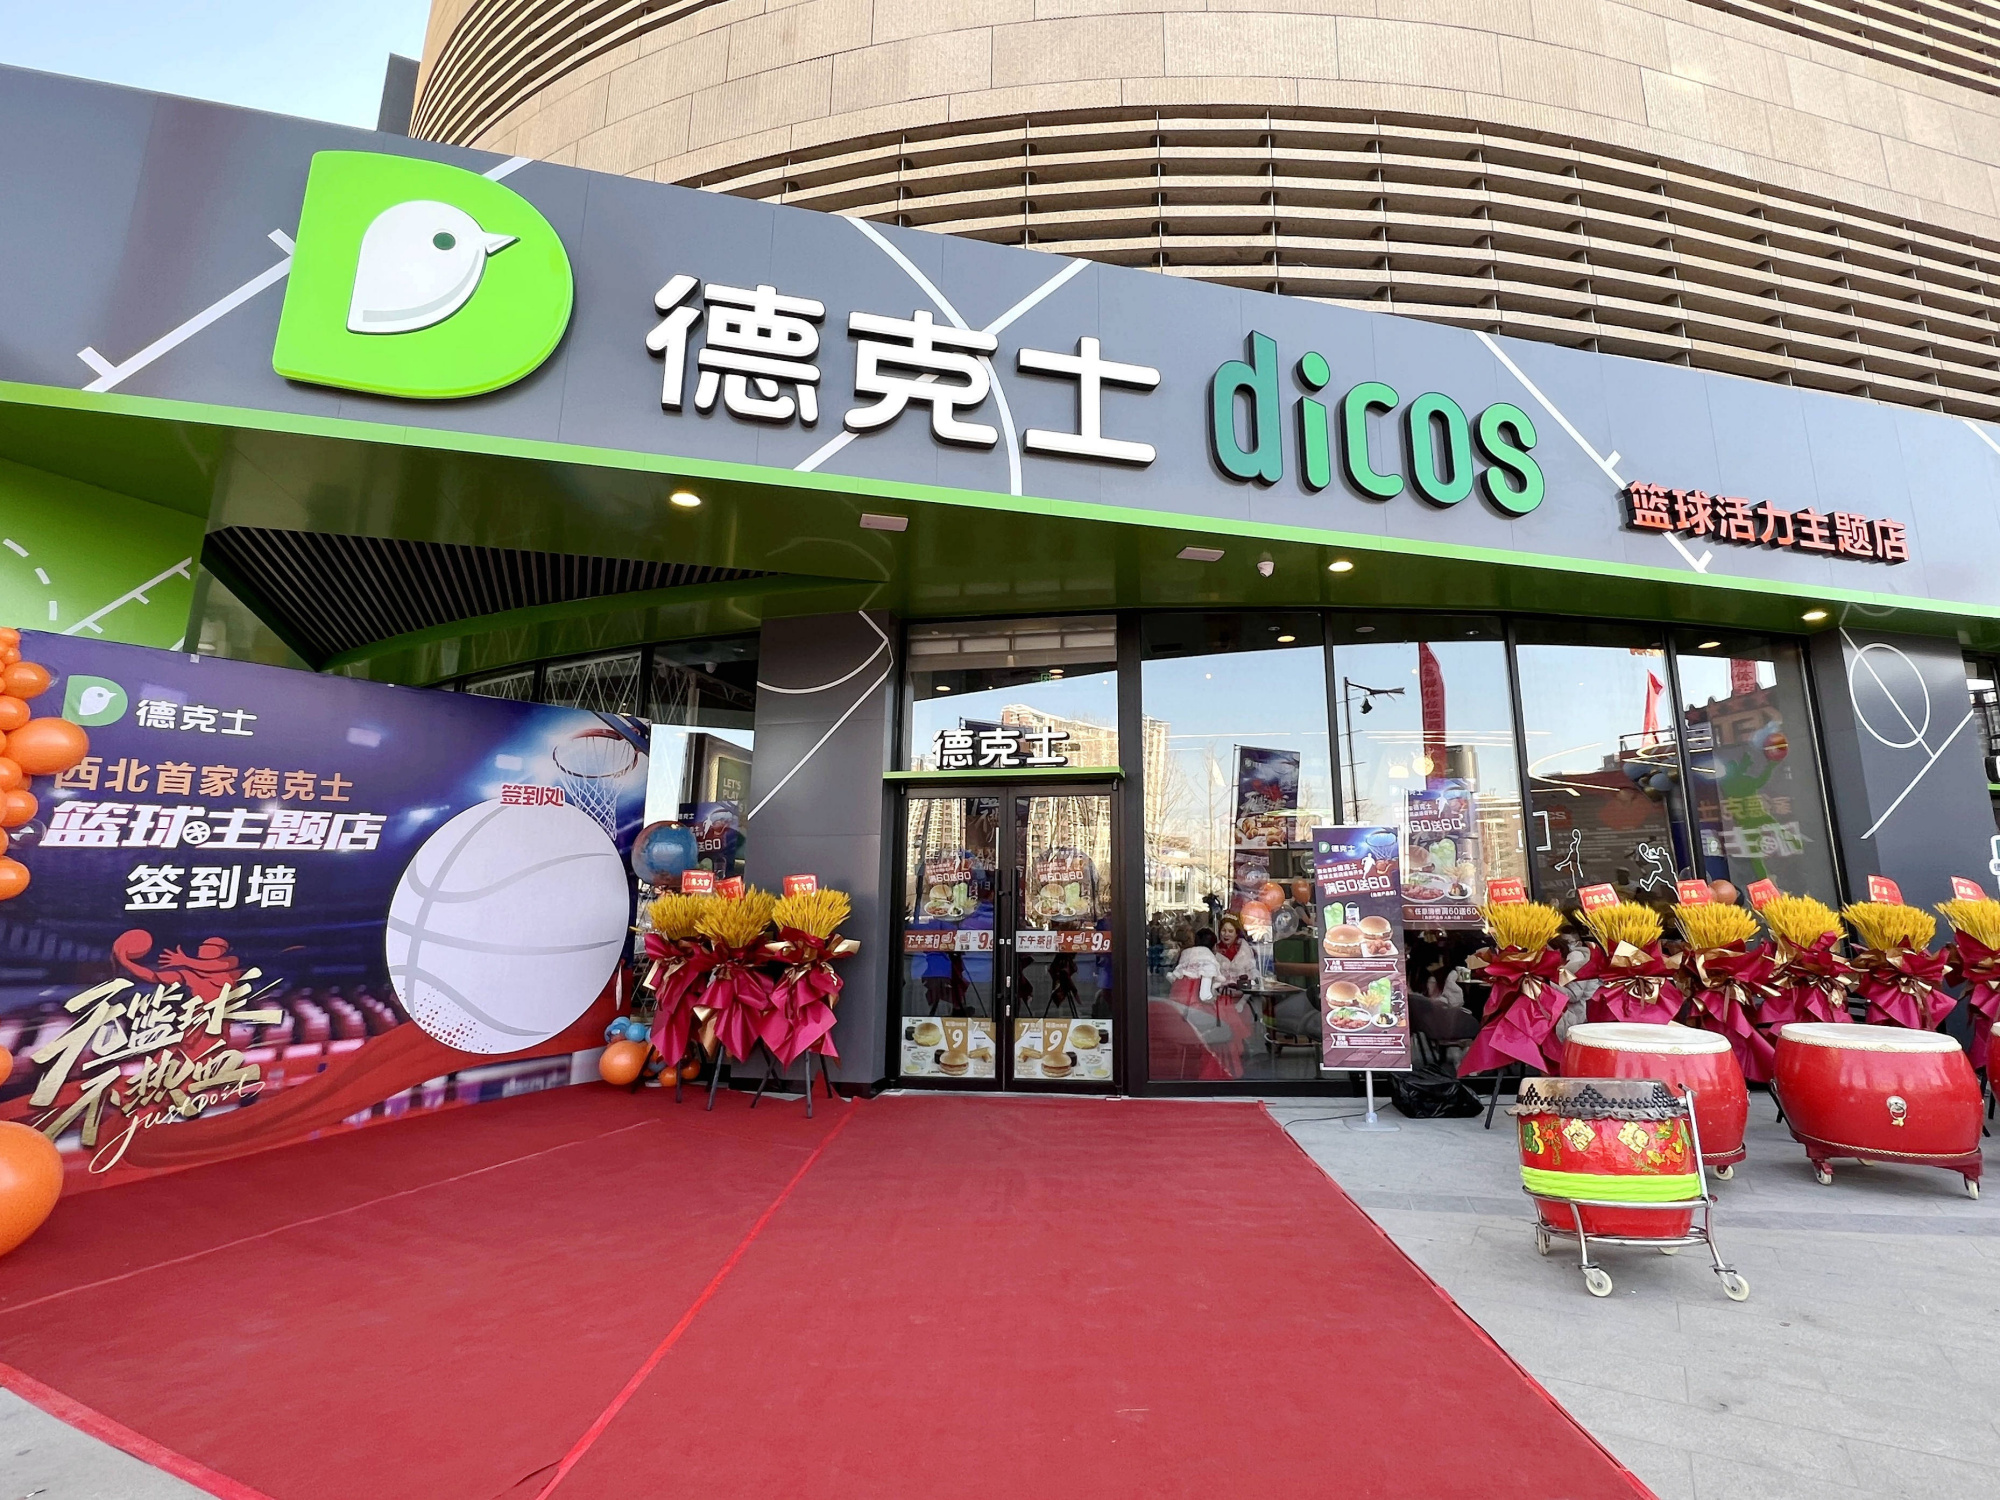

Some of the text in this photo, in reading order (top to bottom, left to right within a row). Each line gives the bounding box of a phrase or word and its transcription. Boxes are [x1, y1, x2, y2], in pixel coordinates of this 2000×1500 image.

[645, 273, 1162, 467] 德克士
[1209, 330, 1546, 518] dicos
[1625, 480, 1909, 563] 篮球活力主题店
[136, 699, 258, 736] 德克士
[931, 726, 1069, 768] 德克士
[54, 756, 353, 802] 西北首家德克士
[500, 784, 564, 807] 签到处
[722, 790, 740, 800] PLAY
[723, 778, 741, 790] LET'S
[38, 800, 387, 851] 篮球主题店
[1331, 844, 1355, 853] 德克士
[124, 864, 297, 911] 签到墙
[1324, 875, 1391, 895] 满60送60
[907, 934, 934, 945] 下午茶
[1018, 935, 1046, 945] 下午茶
[29, 967, 284, 1106] 无篮球
[33, 1039, 261, 1147] 不热血
